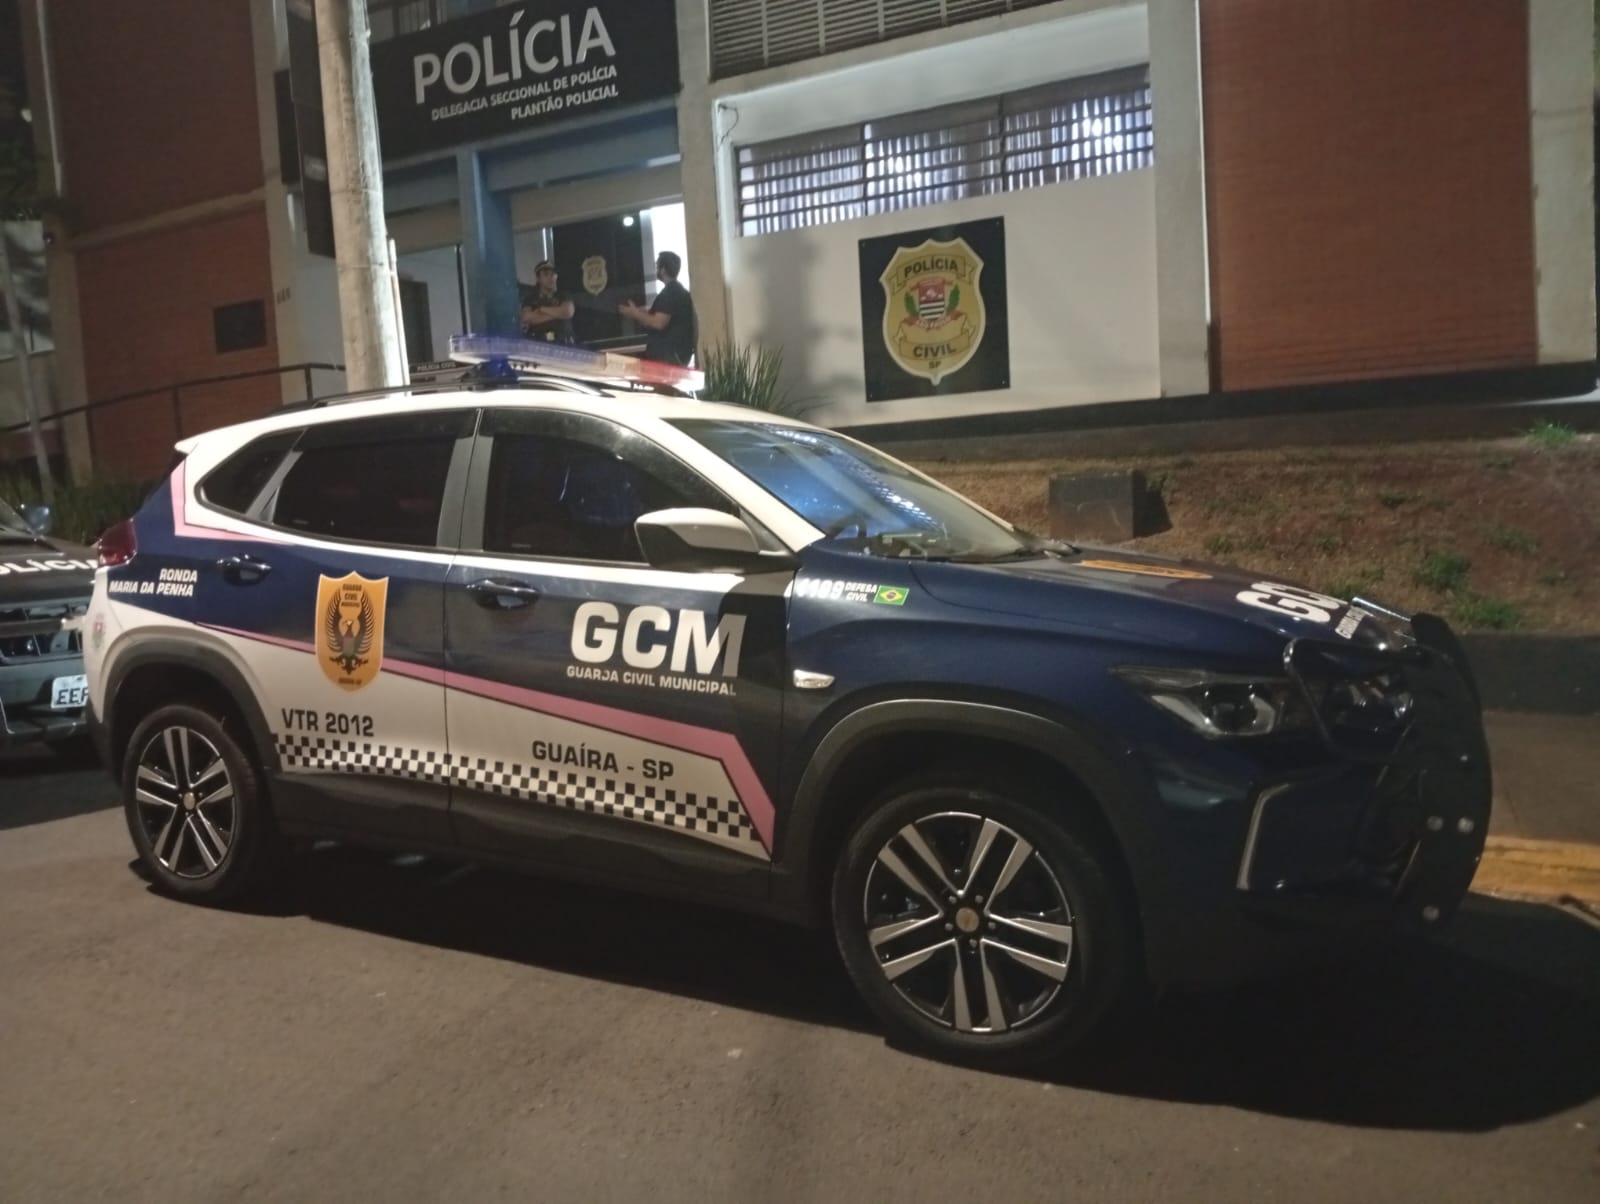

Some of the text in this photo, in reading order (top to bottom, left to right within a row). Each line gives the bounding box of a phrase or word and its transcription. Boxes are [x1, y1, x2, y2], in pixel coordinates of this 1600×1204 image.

[413, 6, 616, 105] POLÍCIA
[431, 64, 618, 121] DELEGACIA SECCIONAL DE POLÍCIA
[511, 84, 619, 120] PLANTÃO POLICIAL
[904, 258, 959, 278] POLÍCIA
[913, 345, 957, 359] CIVIL
[929, 361, 941, 369] SP
[159, 568, 198, 583] RONDA
[108, 580, 194, 597] MARIA DA PENHA
[845, 592, 868, 602] CIVIL
[571, 601, 747, 678] GCM
[622, 671, 656, 687] CIVIL
[659, 675, 737, 696] MUNICIPAL
[281, 708, 375, 737] VTR 2012
[532, 741, 619, 773] GUAÍRA
[642, 759, 674, 780] SP
